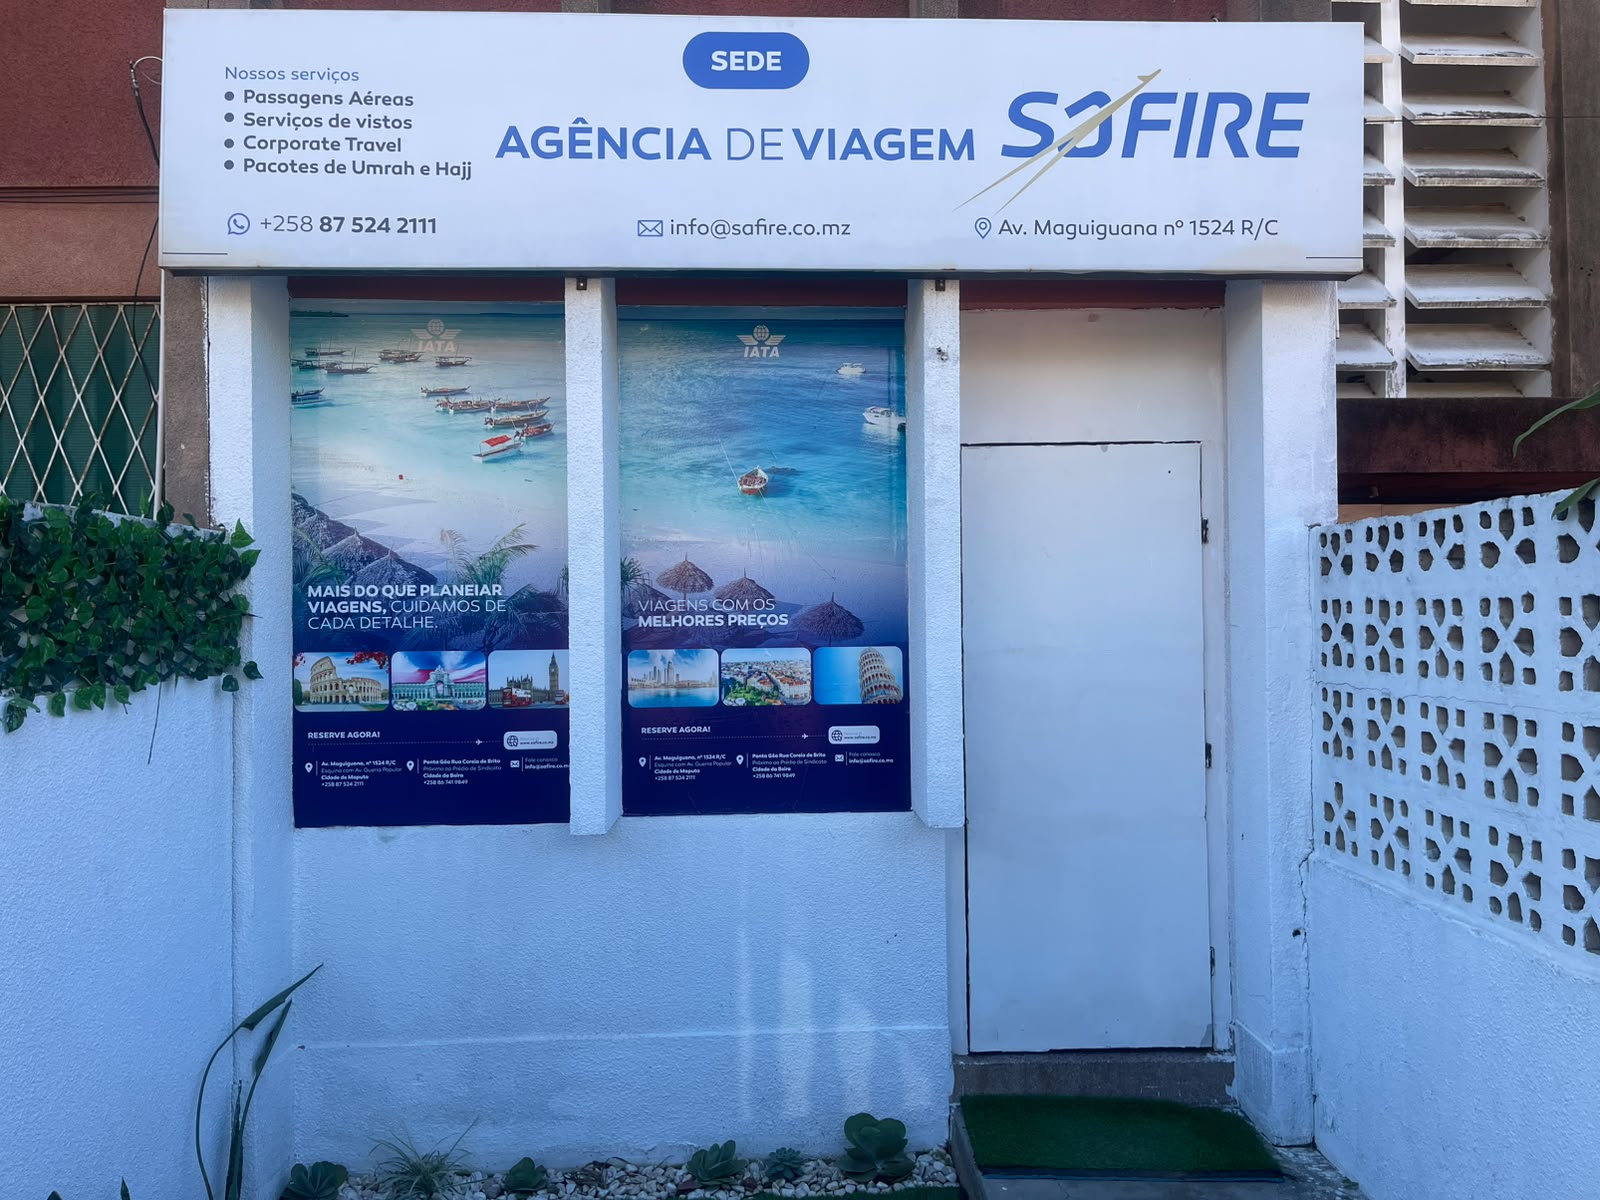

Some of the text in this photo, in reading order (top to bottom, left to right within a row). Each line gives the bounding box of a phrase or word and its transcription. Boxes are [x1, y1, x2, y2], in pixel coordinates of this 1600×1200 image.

[711, 50, 782, 72] SEDE
[225, 66, 360, 84] Nossos serviços
[243, 89, 414, 109] Passagens Aéreas
[243, 112, 413, 131] Serviços de vistos
[243, 135, 402, 154] Corporate Travel
[495, 117, 976, 161] AGÊNCIA DE VIAGEM
[243, 158, 472, 181] Pacotes de Umrah e Hajj
[260, 215, 437, 234] +258 87 524 2111
[670, 218, 851, 239] info@safire.co.mz
[998, 219, 1028, 235] Av.
[1034, 219, 1157, 240] Maguiguana
[1189, 219, 1235, 236] 1524
[1241, 218, 1279, 240] R/C
[418, 340, 456, 353] IATA
[743, 346, 780, 358] IATA
[307, 583, 502, 599] MAIS DO QUE PLANEIAR
[307, 599, 507, 614] VIAGENS, CUIDAMOS DE
[638, 598, 775, 612] VIAGENS COM OS
[308, 616, 439, 630] CADA DETALHE.
[638, 613, 789, 628] MELHORES PREÇOS
[307, 731, 346, 739] RESERVE
[641, 726, 678, 734] RESERVE
